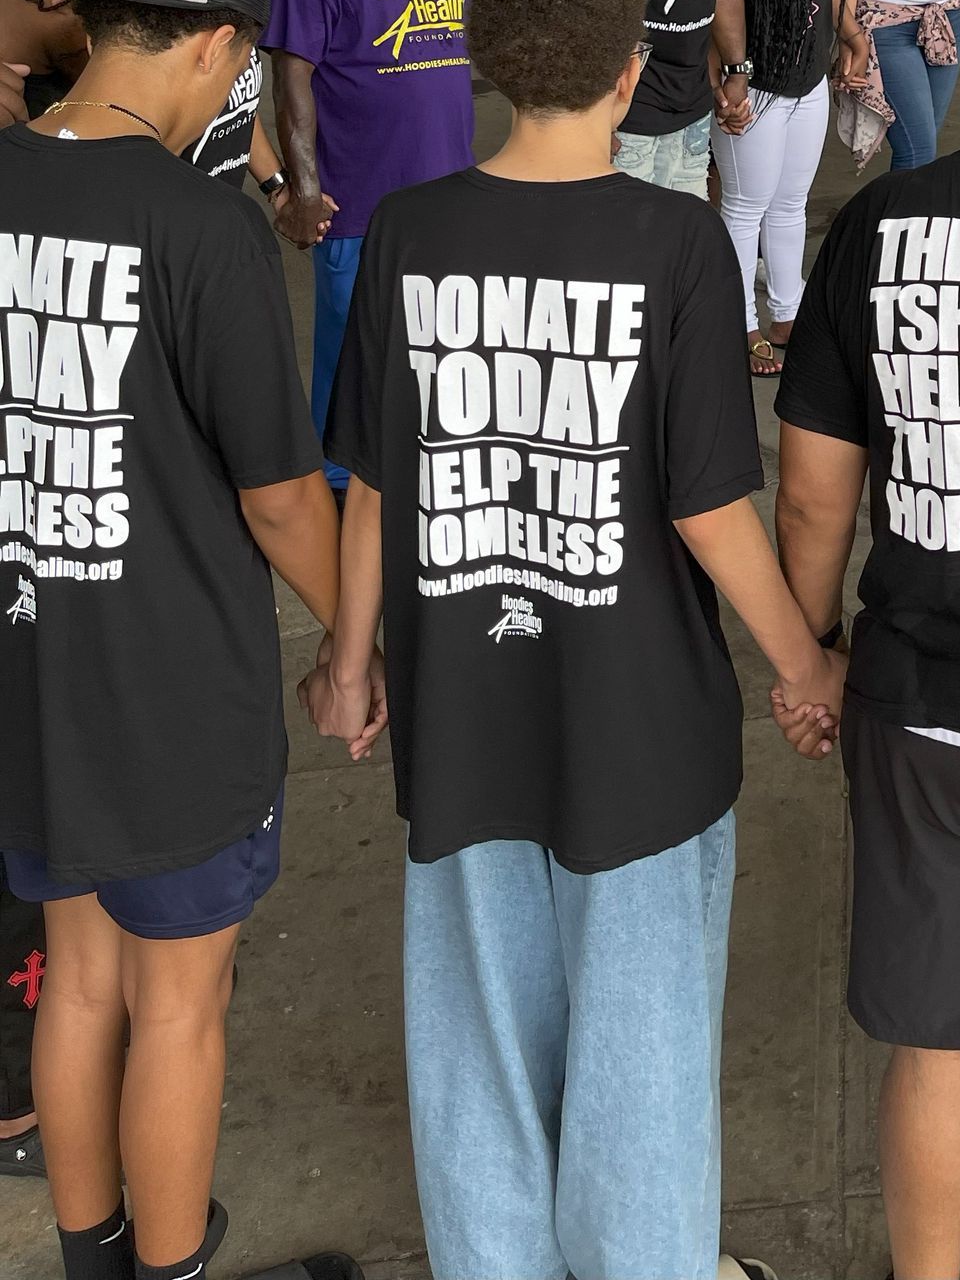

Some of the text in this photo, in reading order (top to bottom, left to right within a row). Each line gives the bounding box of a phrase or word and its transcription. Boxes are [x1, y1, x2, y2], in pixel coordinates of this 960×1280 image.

[372, 1, 465, 60] 4
[408, 32, 464, 43] FOUNDATIO
[402, 274, 646, 357] DONATE
[0, 312, 138, 411] DAY
[408, 349, 639, 446] TODAY
[418, 447, 620, 519] HELP THE
[501, 594, 534, 616] Hoodies
[511, 609, 543, 633] Healing
